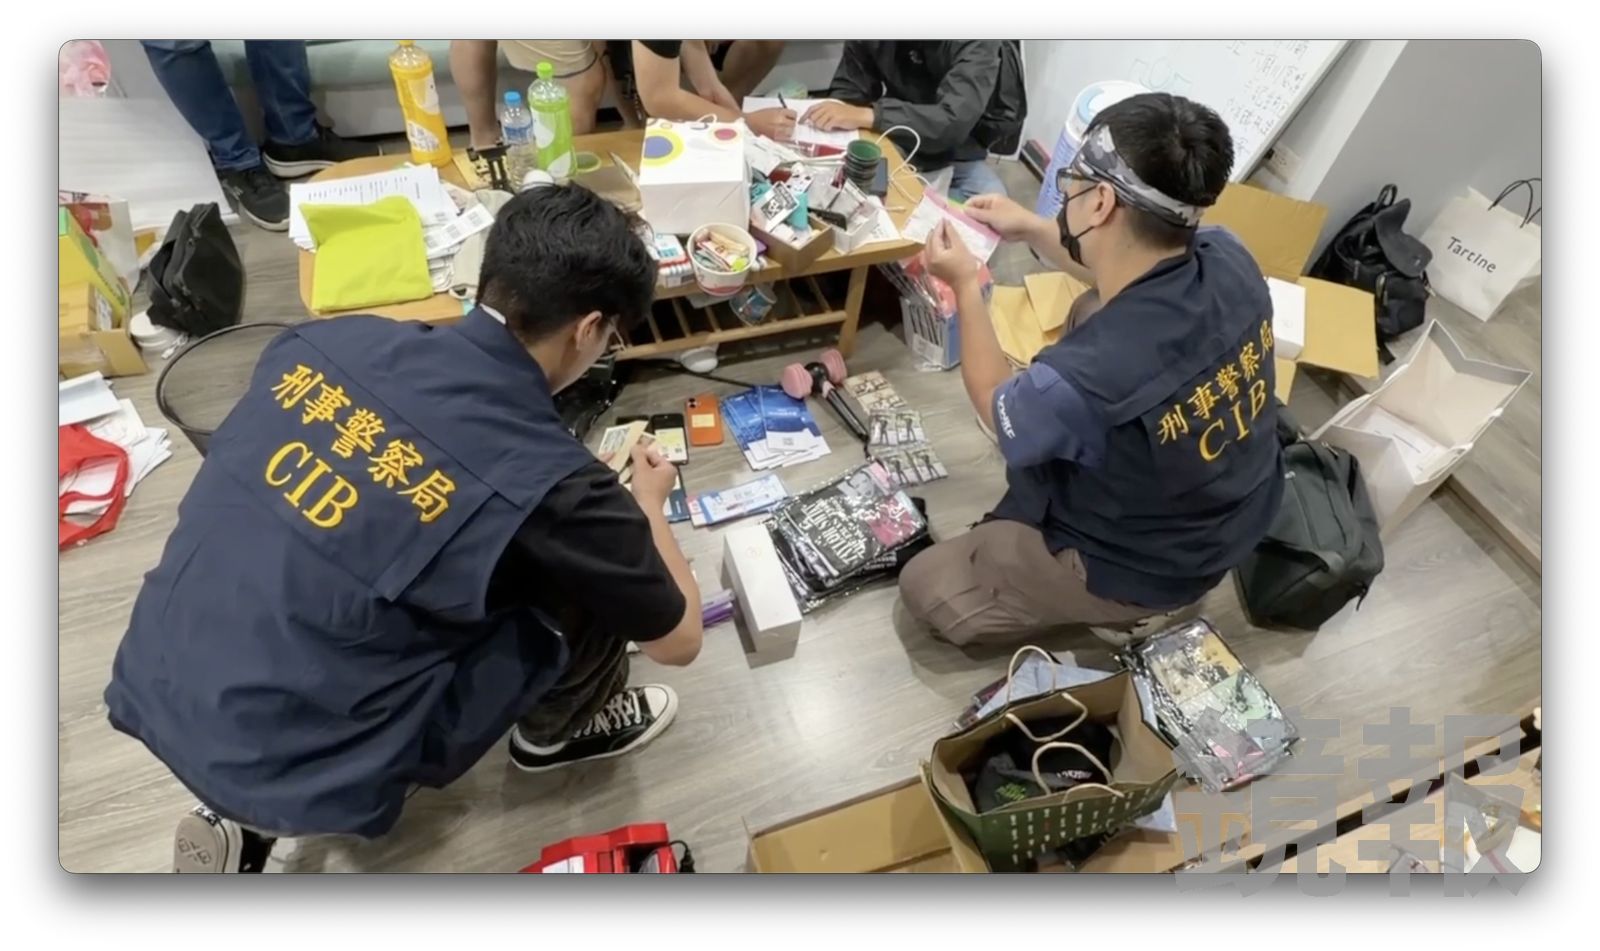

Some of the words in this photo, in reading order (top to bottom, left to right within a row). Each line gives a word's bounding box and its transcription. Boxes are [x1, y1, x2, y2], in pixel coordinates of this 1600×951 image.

[1446, 236, 1498, 274] Tartine
[271, 364, 457, 523] 刑事警察局
[1199, 379, 1267, 462] CIB
[264, 440, 359, 529] CIB
